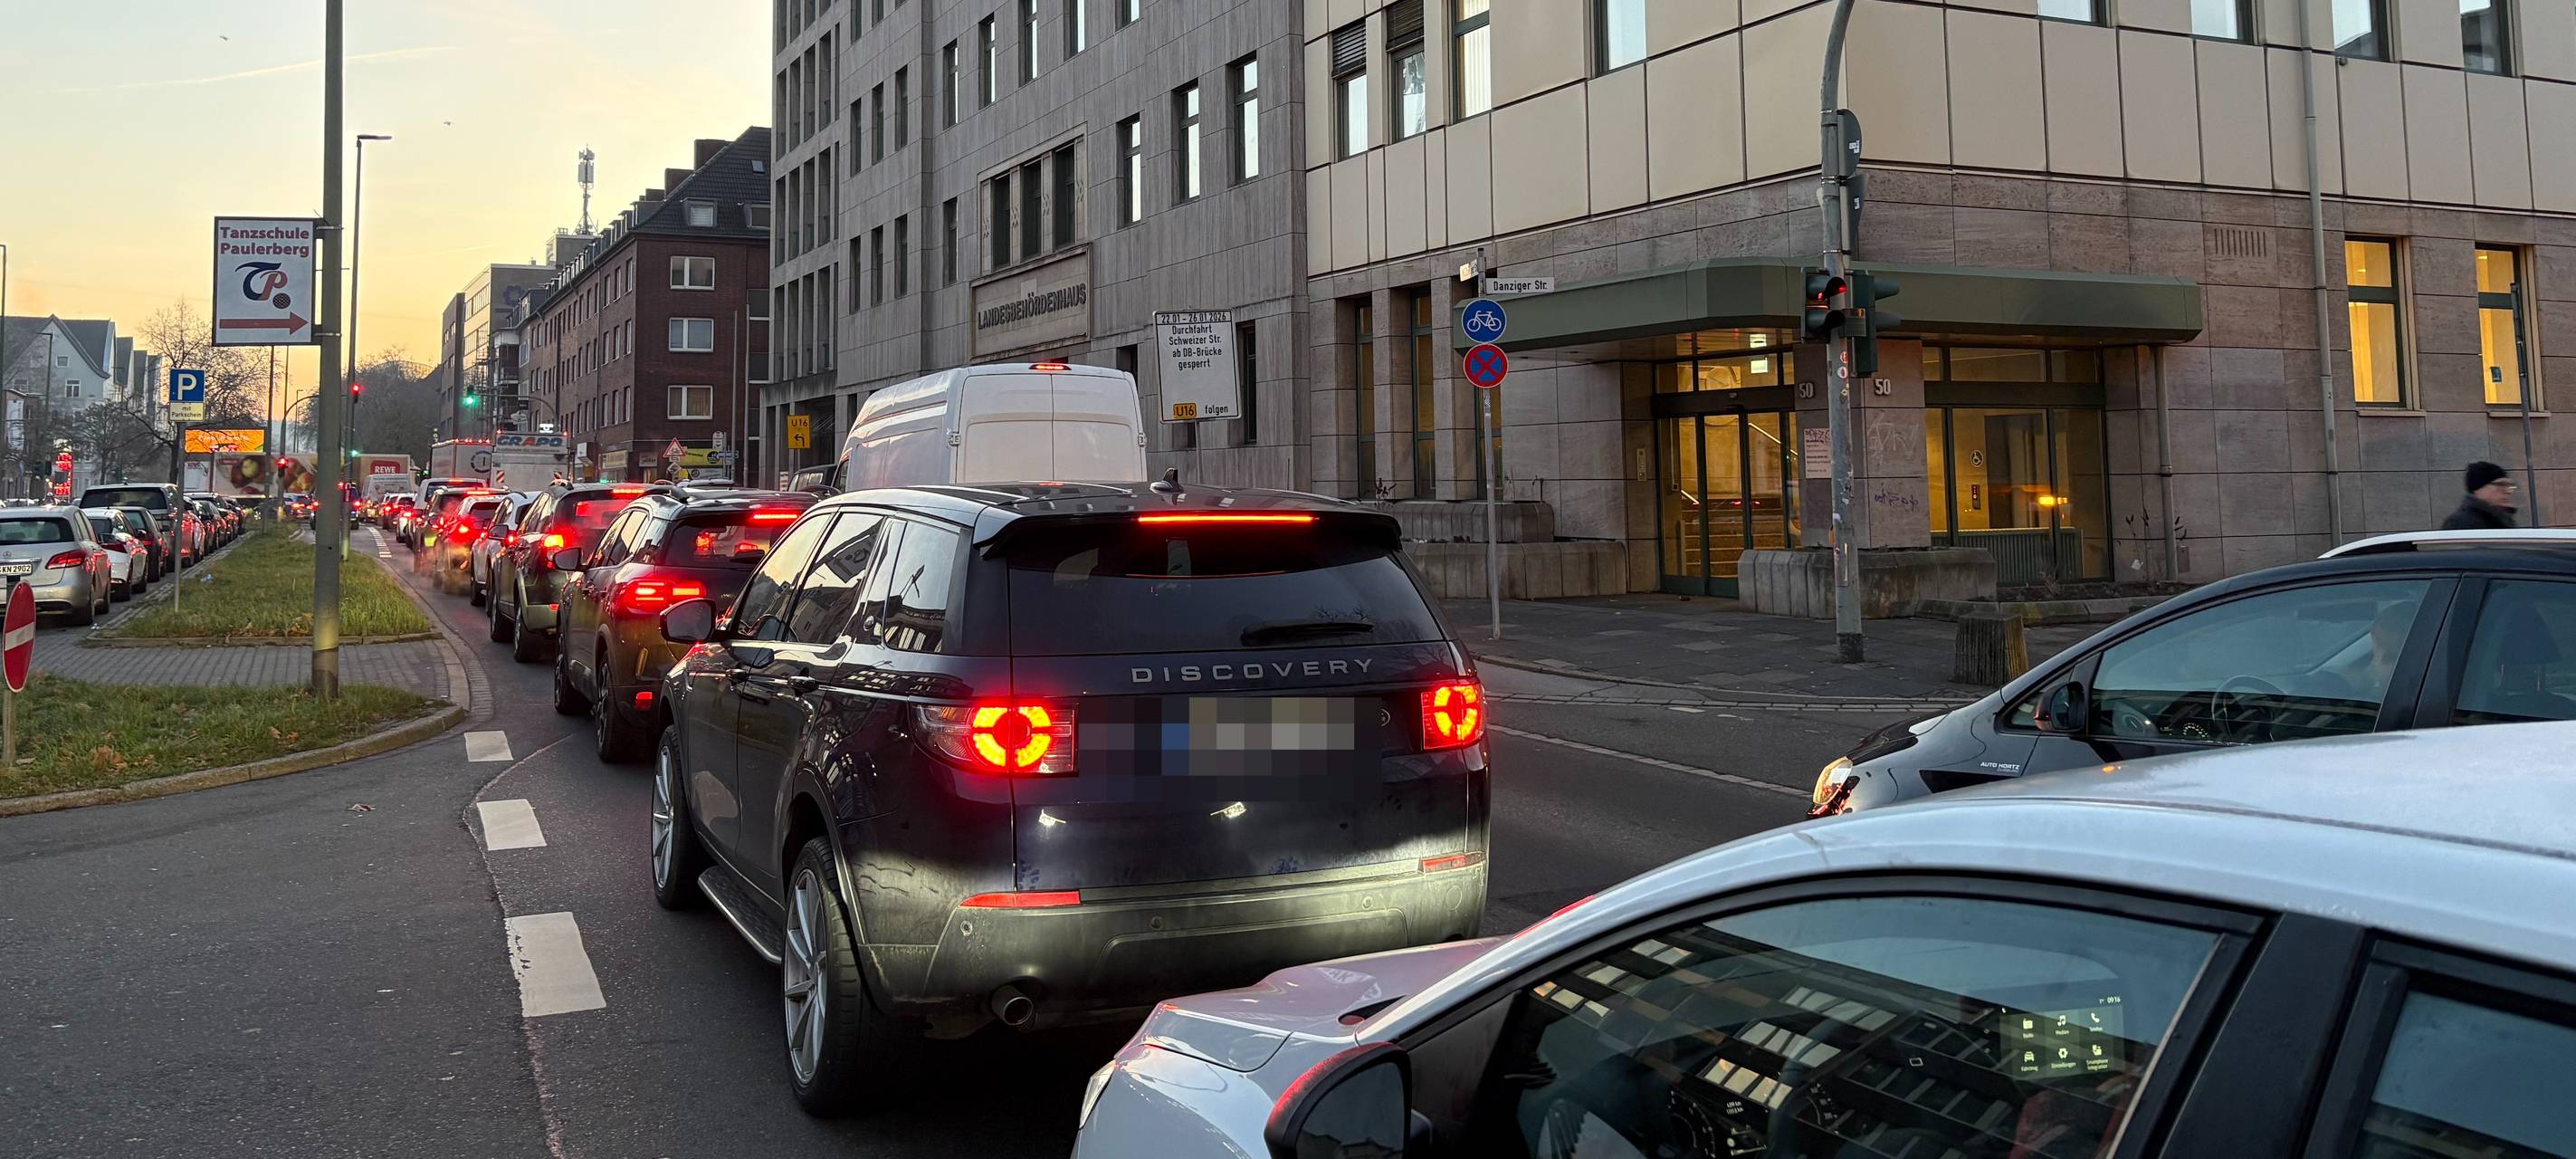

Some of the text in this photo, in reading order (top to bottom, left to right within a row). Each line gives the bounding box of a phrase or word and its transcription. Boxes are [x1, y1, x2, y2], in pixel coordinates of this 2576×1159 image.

[220, 226, 310, 239] Tanzschule
[220, 243, 310, 258] Paulerberg
[1493, 280, 1548, 292] Danziger Str.
[978, 283, 1086, 330] LANDESBEHÖRDENHAUS
[1188, 311, 1226, 322] 26.01.2026
[1172, 324, 1213, 334] Durchfahrt
[1169, 334, 1222, 345] Schweizer Str.
[1172, 347, 1222, 358] ab DB-Brücke
[1178, 359, 1210, 370] gesperrt
[177, 373, 197, 400] P
[1798, 382, 1814, 398] 50
[1875, 378, 1891, 395] 50
[1177, 405, 1228, 417] U16 folgen
[374, 465, 396, 474] REWE
[1131, 658, 1372, 683] DISCOVERY
